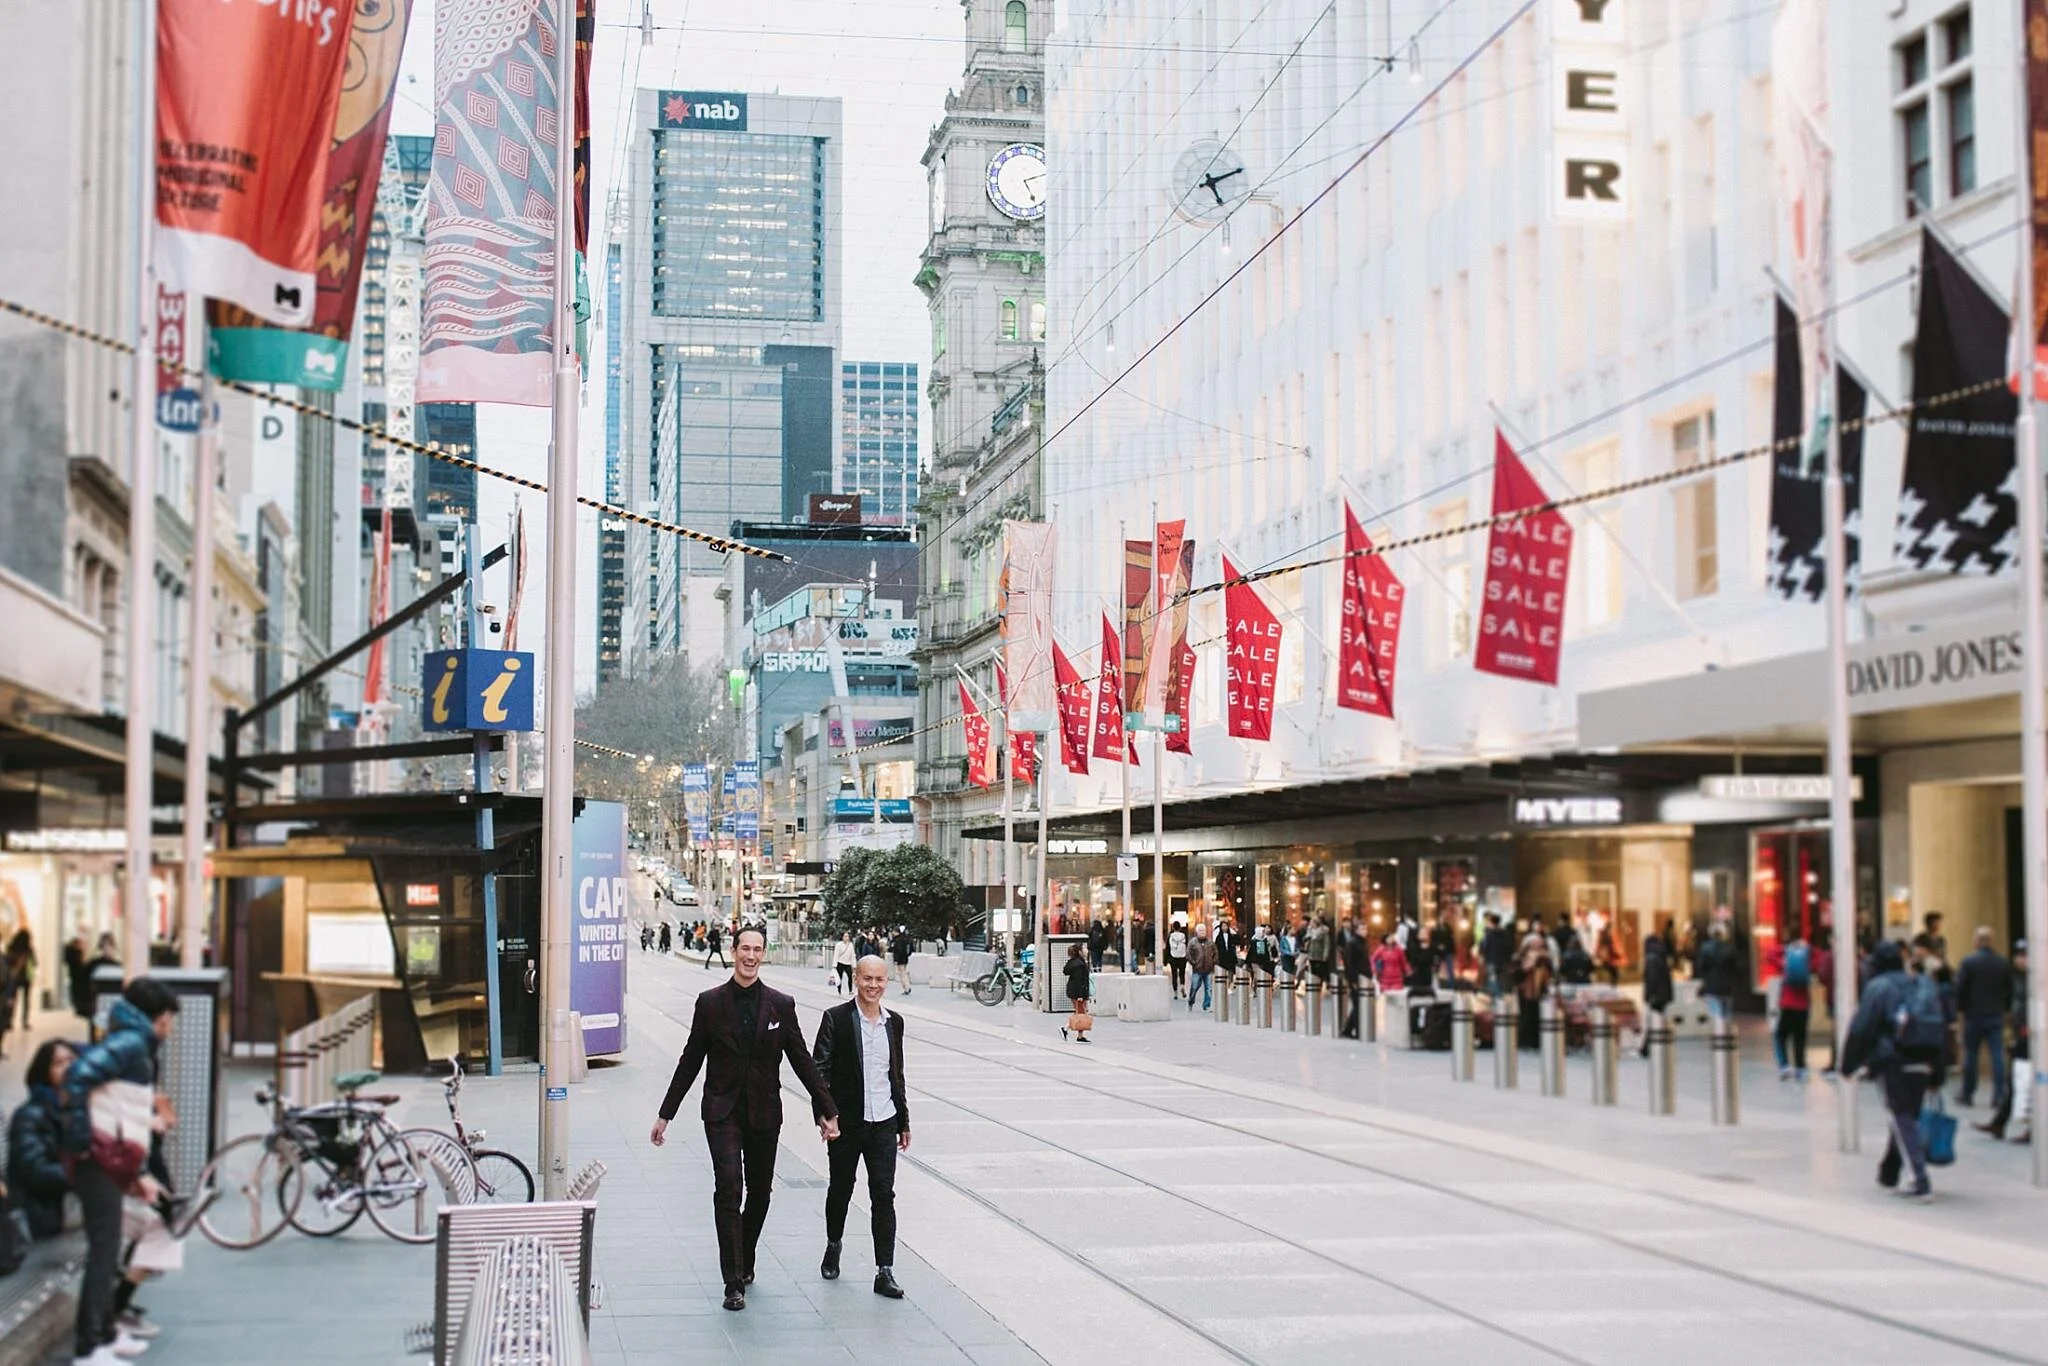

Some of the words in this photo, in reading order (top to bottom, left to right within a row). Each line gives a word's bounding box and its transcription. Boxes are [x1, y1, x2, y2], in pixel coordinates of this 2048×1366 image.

[694, 100, 740, 121] nab
[1491, 546, 1565, 580] SALE
[1487, 580, 1561, 614] SALE
[1483, 613, 1557, 647] SALE
[1846, 650, 1924, 697] DAVID
[1930, 631, 2024, 686] JONES
[1515, 798, 1622, 823] MYER
[1048, 839, 1108, 854] MYER
[579, 924, 617, 942] WINTER
[592, 944, 610, 962] THE
